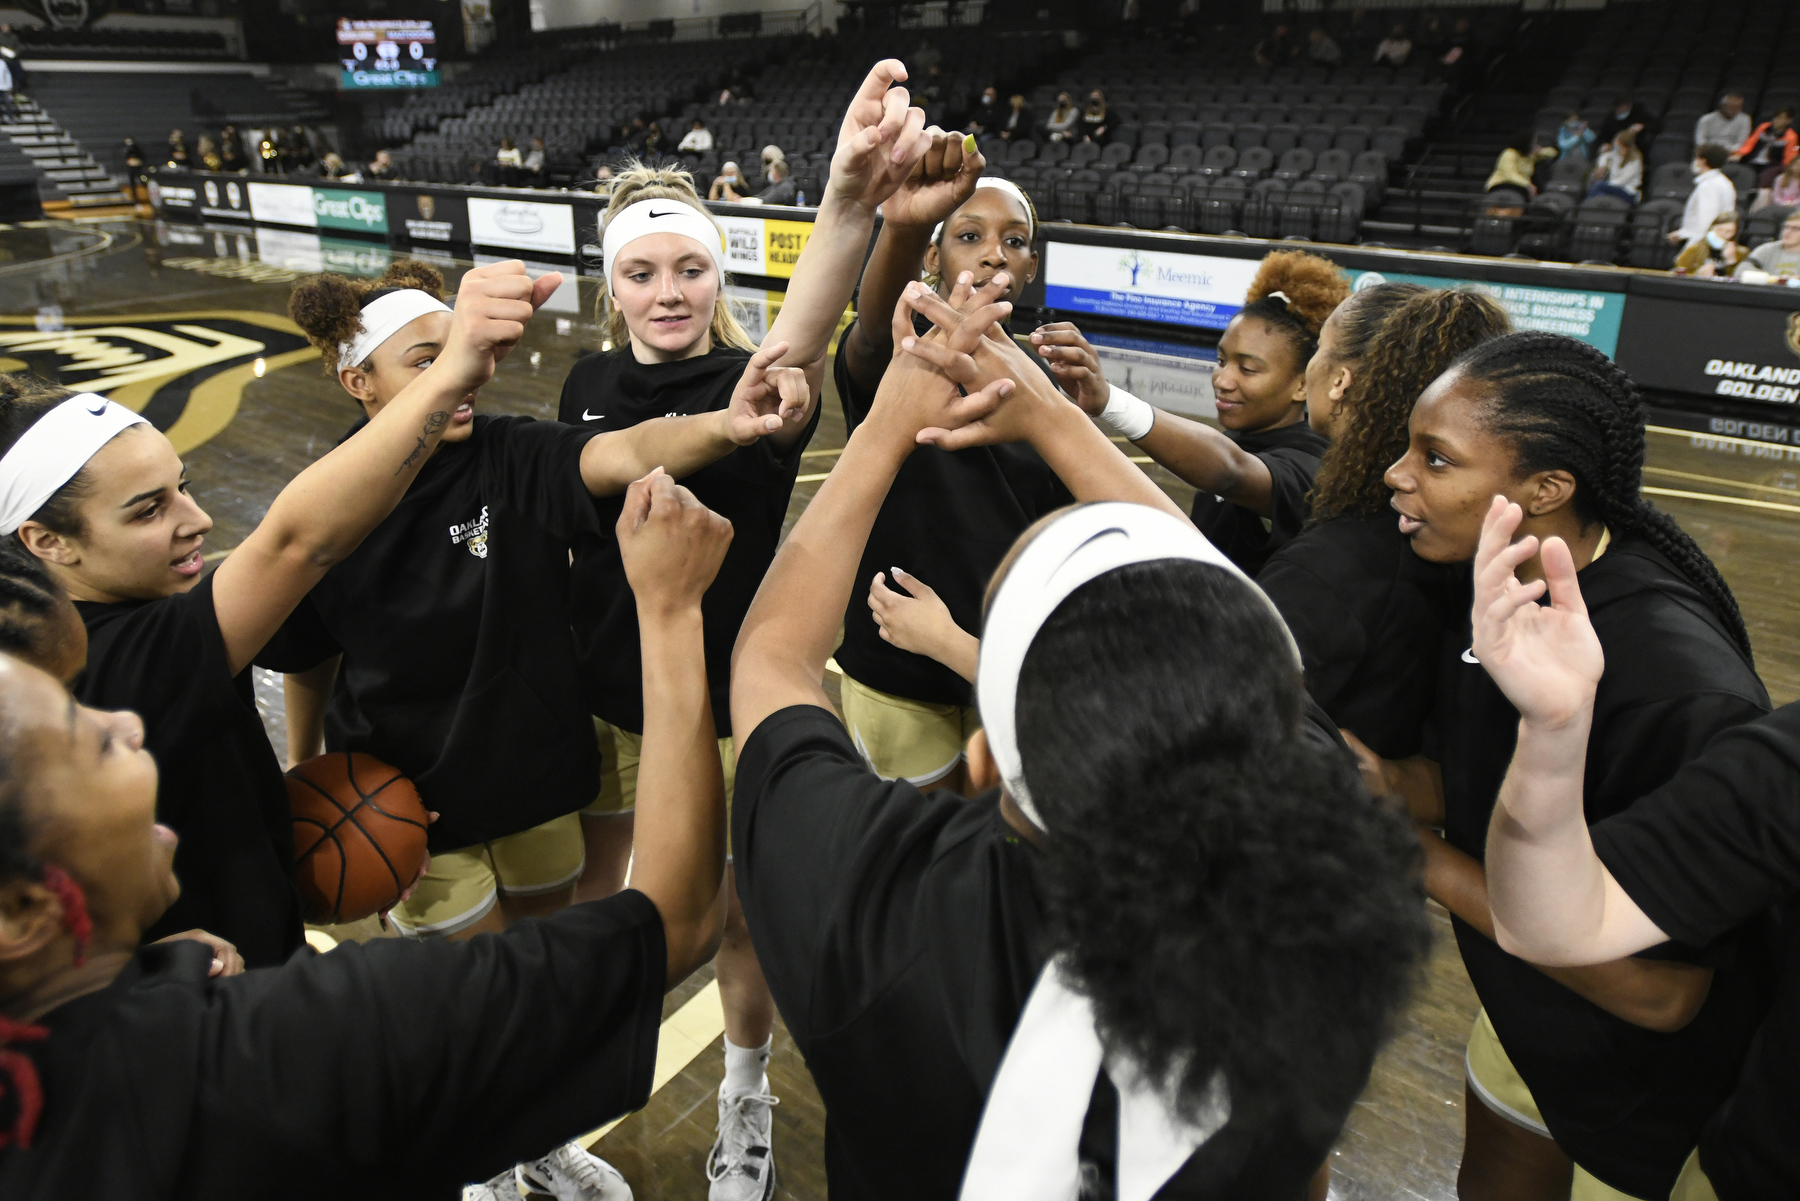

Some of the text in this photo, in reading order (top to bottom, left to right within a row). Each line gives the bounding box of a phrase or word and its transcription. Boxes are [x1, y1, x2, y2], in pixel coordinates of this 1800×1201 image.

[314, 192, 350, 219] Great
[349, 195, 384, 227] Clips
[730, 236, 758, 250] WILD
[770, 231, 802, 250] POST
[1158, 266, 1213, 285] Meemic
[1144, 294, 1183, 308] Insurance
[1184, 300, 1216, 314] Agency
[1504, 287, 1588, 308] INTERNSHIPS
[1589, 295, 1605, 310] IN
[1532, 303, 1596, 323] BUSINESS
[1704, 359, 1800, 385] OAKLAND
[1715, 379, 1800, 404] GOLDEN
